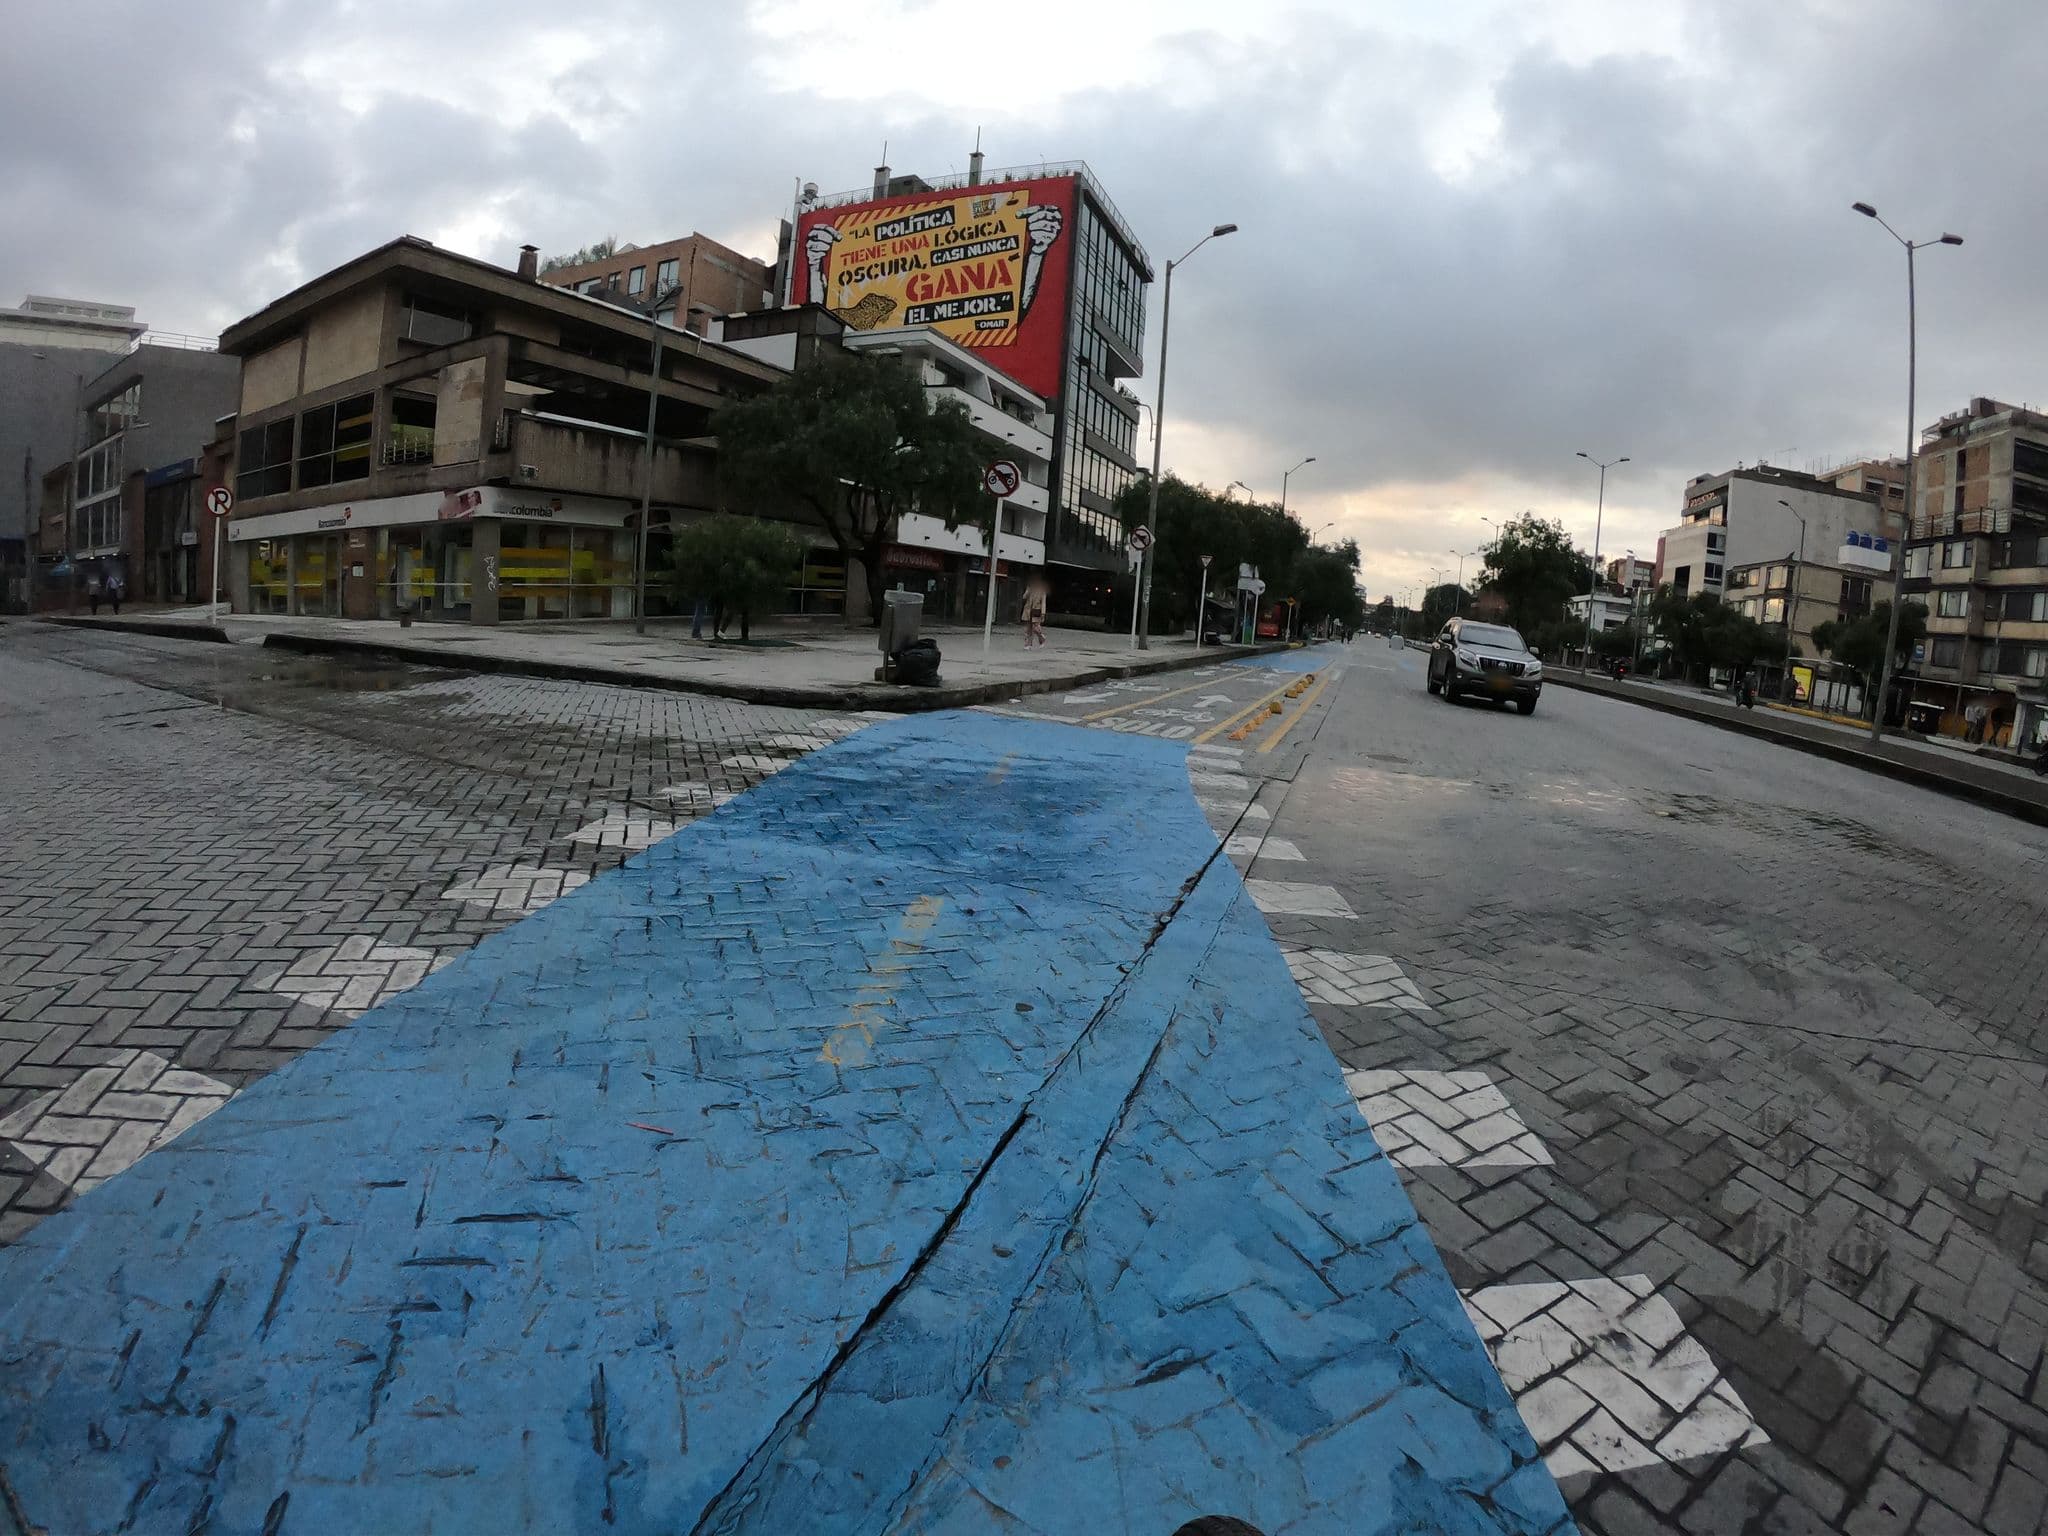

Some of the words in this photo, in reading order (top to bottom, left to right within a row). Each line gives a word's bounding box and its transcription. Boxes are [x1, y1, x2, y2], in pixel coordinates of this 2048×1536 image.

[840, 244, 887, 266] TIENE
[892, 234, 930, 255] UNA
[934, 220, 1007, 247] LÓGICA
[877, 210, 953, 241] POLÍTICA
[838, 254, 928, 287] OSCURA,
[932, 247, 965, 264] CASI
[967, 237, 1017, 257] NUNCA
[905, 258, 1014, 303] GANA
[908, 307, 931, 324] EL
[1087, 717, 1196, 739] SOLO
